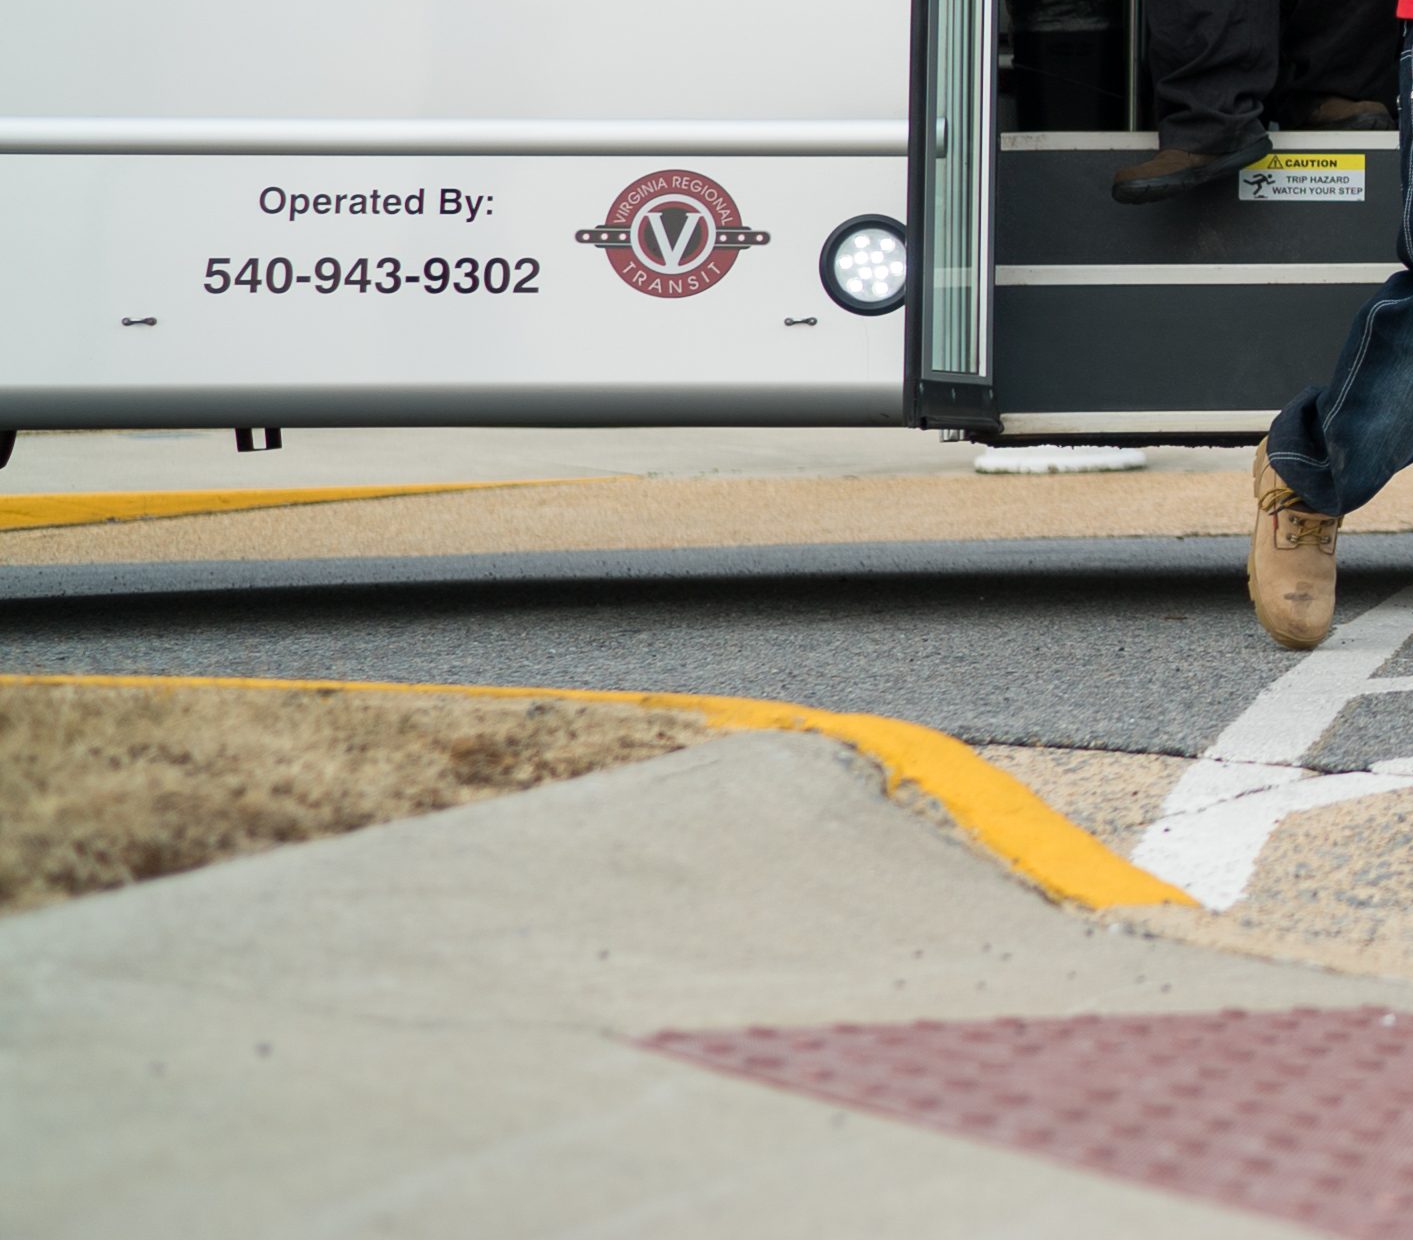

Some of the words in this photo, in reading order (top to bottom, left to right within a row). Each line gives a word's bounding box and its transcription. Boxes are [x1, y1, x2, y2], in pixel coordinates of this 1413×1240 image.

[1285, 159, 1338, 168] CAUTION
[1286, 176, 1308, 184] TRIP
[1310, 176, 1350, 184] HAZARD
[258, 186, 425, 221] Operated
[439, 187, 494, 222] By:
[613, 177, 668, 224] VIRGINIA
[672, 176, 733, 226] REGIONAL
[1272, 187, 1307, 195] WATCH
[1309, 187, 1335, 195] YOUR
[1338, 187, 1363, 195] STEP
[641, 212, 704, 267] V
[203, 256, 540, 295] 540-943-9302
[622, 261, 720, 293] TRANSIT
